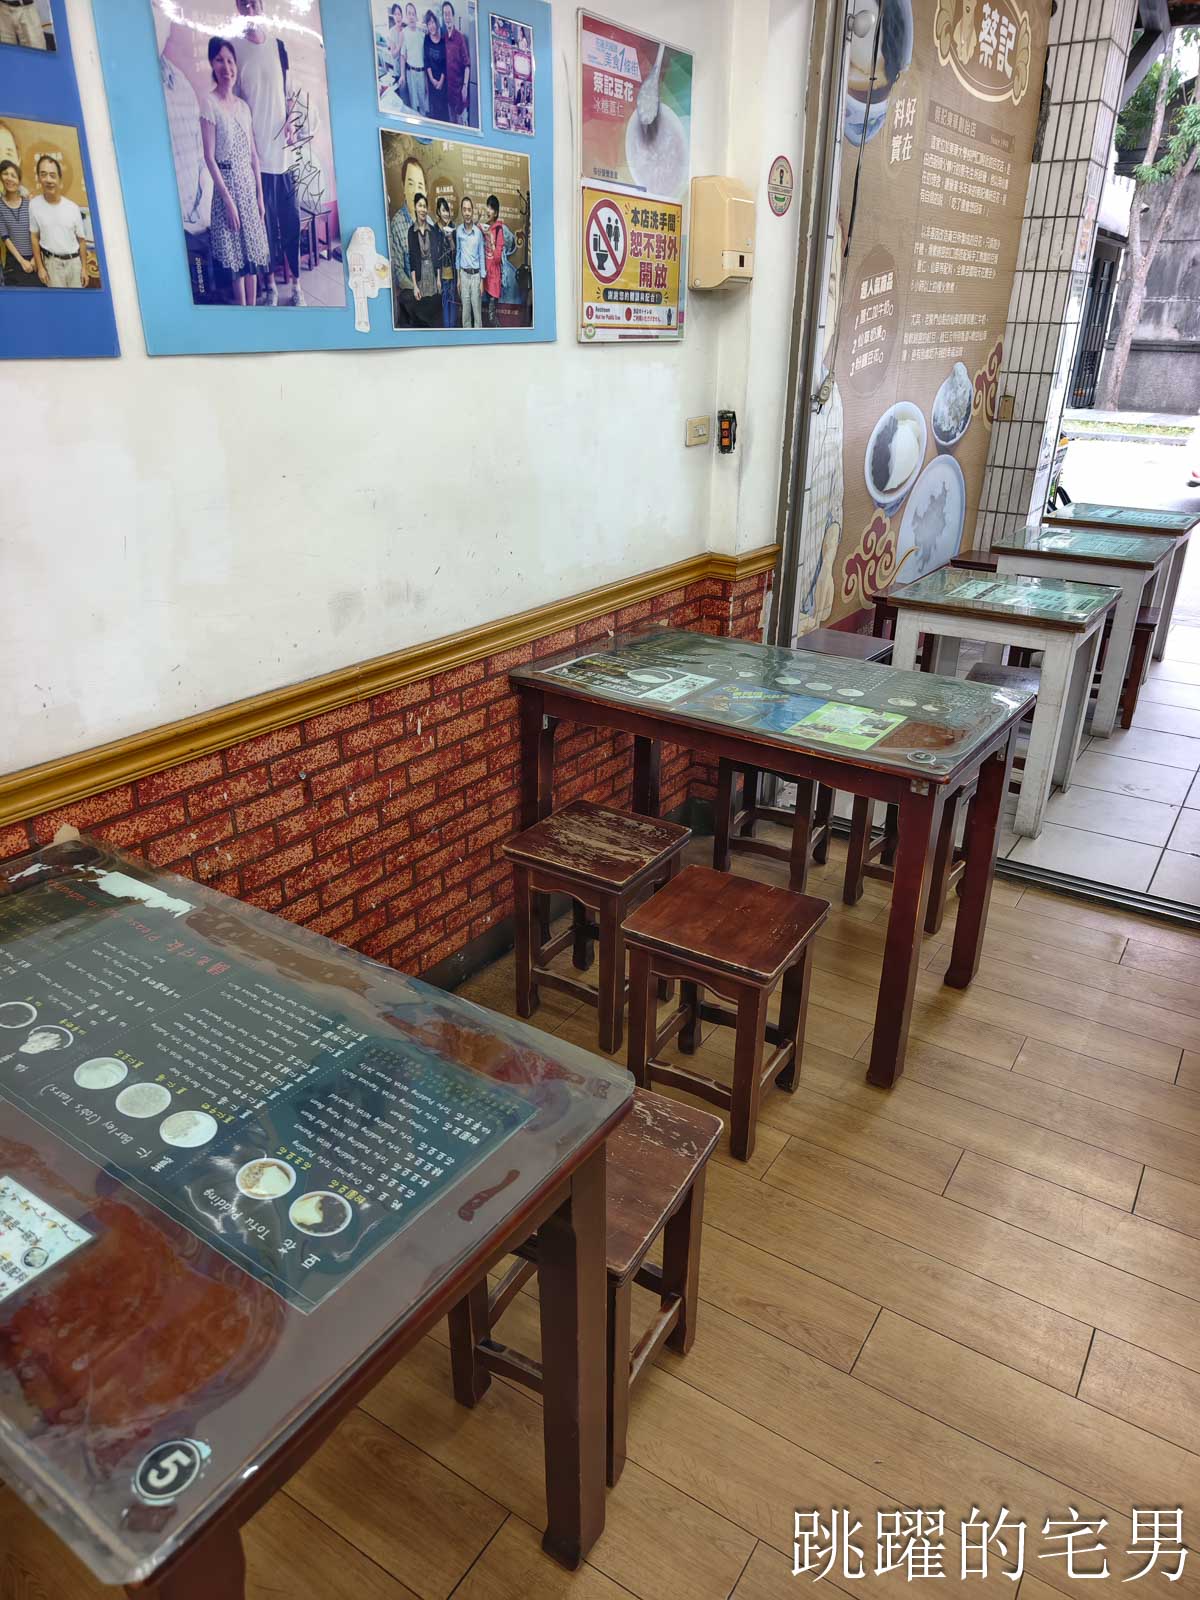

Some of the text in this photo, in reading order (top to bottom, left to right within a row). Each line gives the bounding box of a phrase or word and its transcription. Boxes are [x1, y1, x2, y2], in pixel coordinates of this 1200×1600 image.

[979, 2, 1017, 79] 蔡記
[593, 71, 634, 103] 蔡記豆花
[893, 97, 918, 129] 料好
[889, 133, 914, 165] 實在
[630, 207, 677, 233] 本店洗手間
[629, 229, 678, 261] 恕不對外
[639, 261, 668, 289] 開放
[357, 1076, 380, 1090] Tapioca
[380, 1089, 397, 1100] With
[356, 1062, 493, 1135] 仙草豆花 Tofu Pudding With Grass Jelly
[397, 1097, 423, 1113] Pudding
[38, 1082, 173, 1173] 薏仁 Barley (Job's Tears)
[327, 1092, 455, 1165] 花豆豆花 Tofu Pudding With Speckled
[388, 1109, 429, 1133] Kidney Bean
[422, 1112, 440, 1123] Tofu
[290, 1139, 317, 1157] Pudding
[298, 1109, 430, 1187] 紅豆豆花 Tofu Pudding With Red Bean
[307, 1098, 444, 1177] 綠豆豆花 Tofu Pudding With Mung Bean
[440, 1121, 480, 1145] 粉圓豆花
[274, 1146, 312, 1171] 花生豆花
[292, 1123, 416, 1198] 花生豆花 Tofu Pudding With Peanut
[315, 1155, 333, 1167] Tofu
[333, 1165, 363, 1184] Original
[327, 1178, 366, 1204] 粉圓豆花
[200, 1187, 320, 1270] 豆花 Tofu Pudding
[147, 1449, 191, 1488] 5
